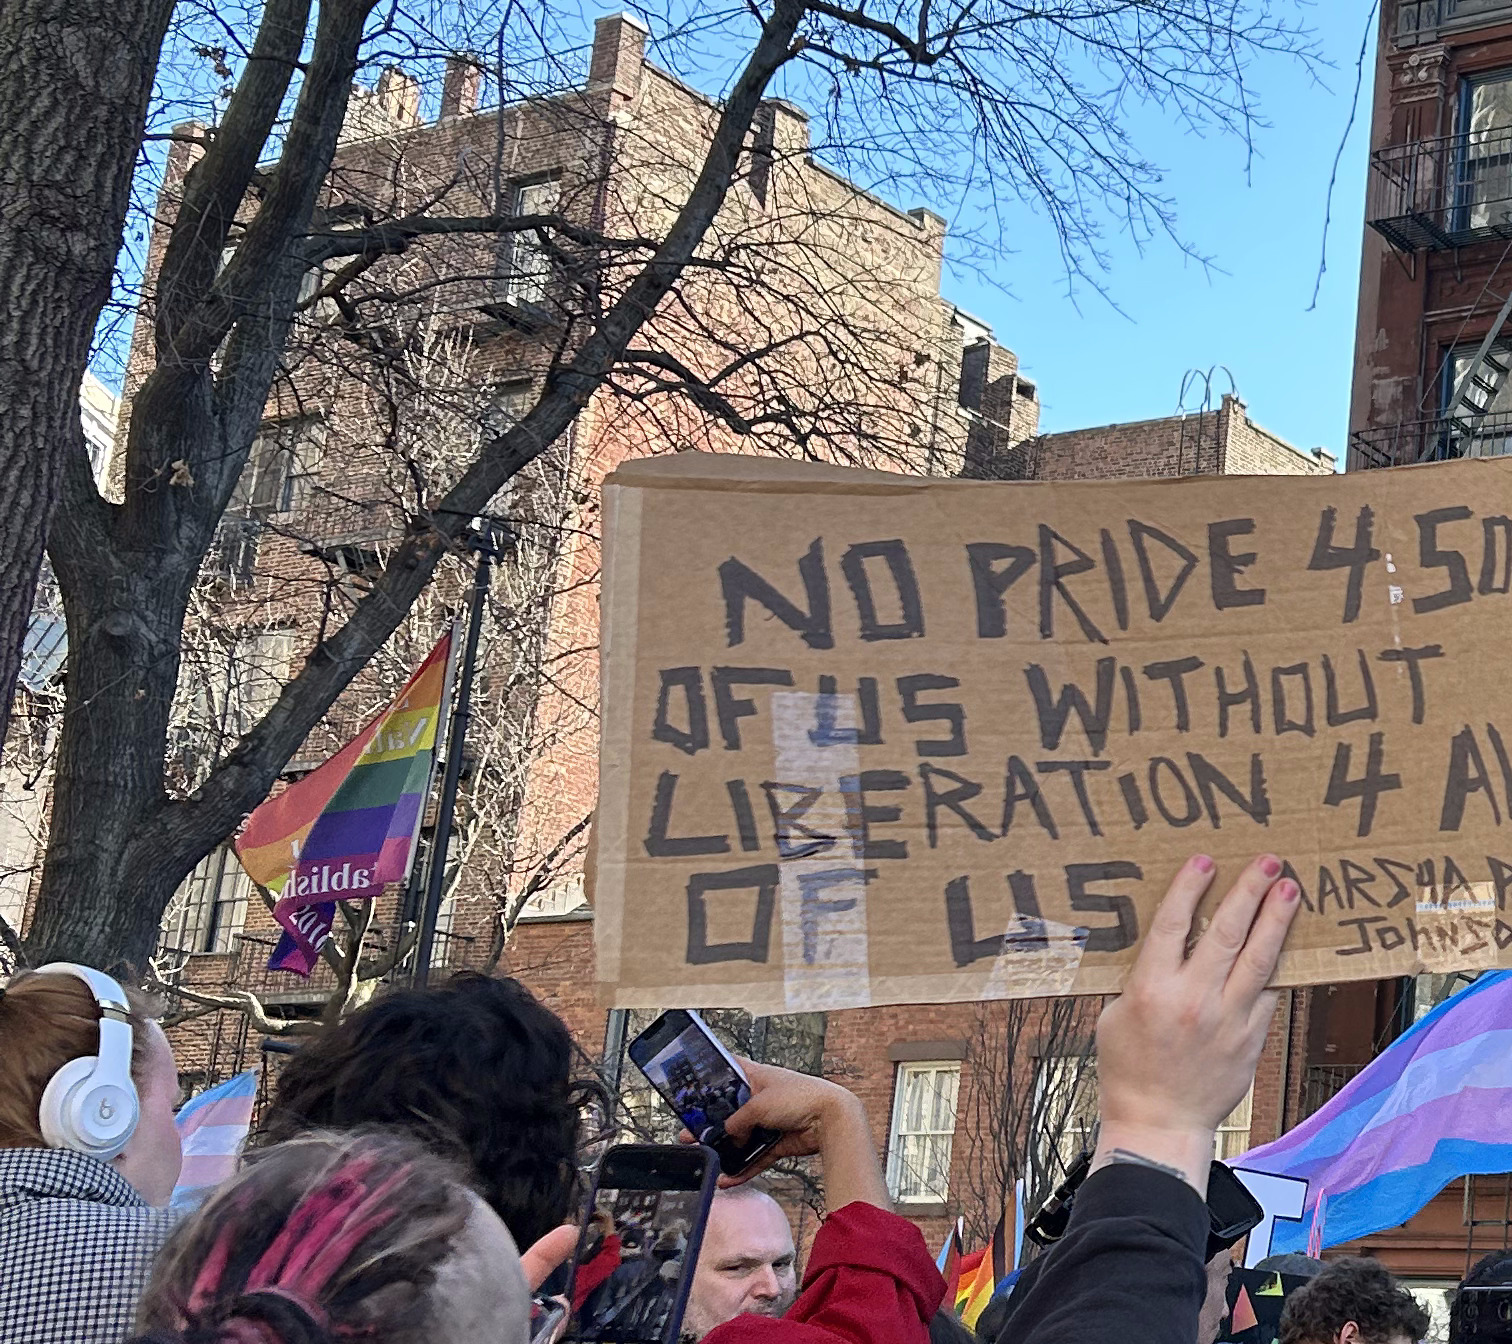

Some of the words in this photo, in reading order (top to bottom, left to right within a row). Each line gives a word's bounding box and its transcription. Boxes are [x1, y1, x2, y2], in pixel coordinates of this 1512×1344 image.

[718, 536, 925, 649] NO
[966, 518, 1266, 645] PRIDE
[1307, 504, 1383, 624] 4
[652, 665, 795, 756] OF
[808, 672, 968, 757] US
[1024, 643, 1446, 757] WITHOUT
[644, 751, 1272, 860] LIBERATION
[1323, 731, 1402, 838] 4
[686, 863, 879, 965] OF
[945, 861, 1144, 967] US
